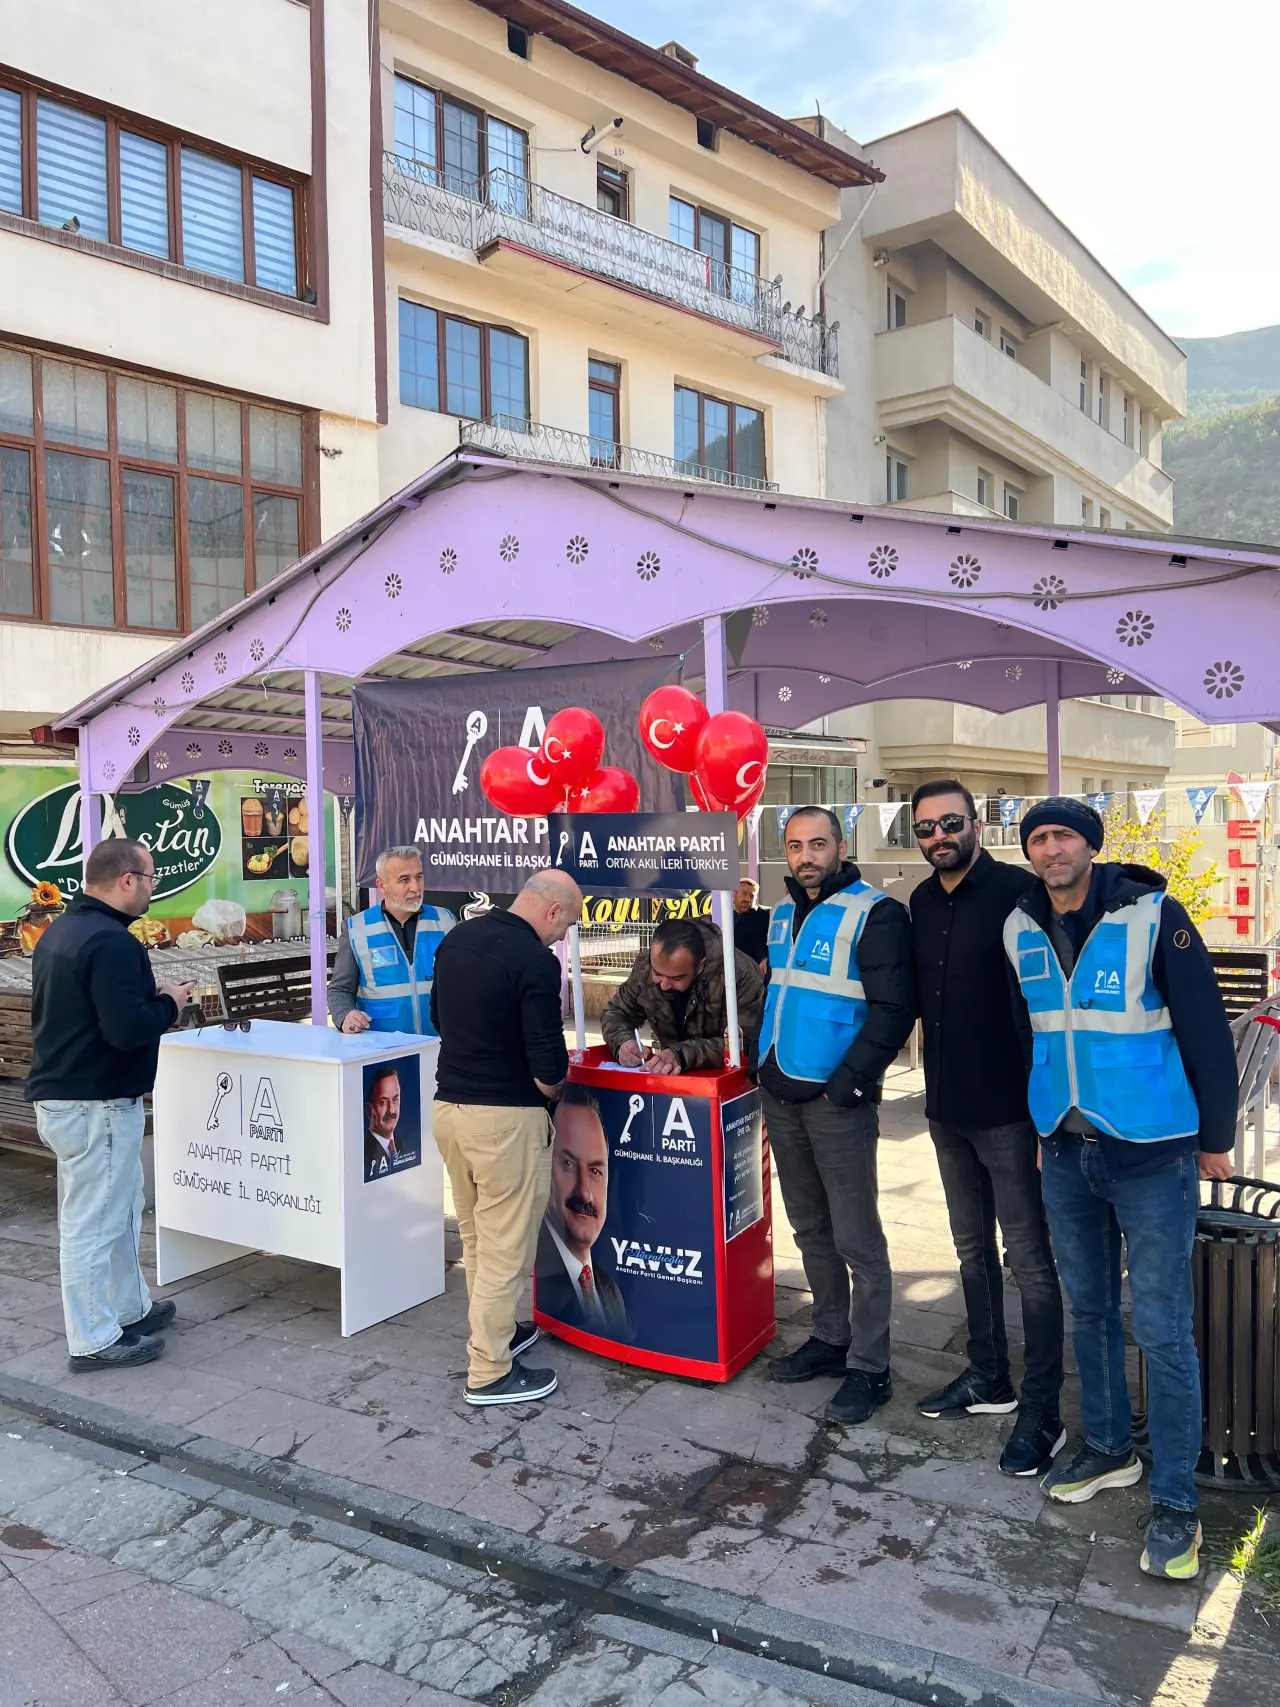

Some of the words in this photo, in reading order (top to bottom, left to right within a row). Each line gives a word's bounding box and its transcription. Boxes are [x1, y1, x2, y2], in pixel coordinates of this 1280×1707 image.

[414, 818, 529, 844] ANAHTAR
[607, 836, 676, 852] ANAHTAR
[680, 832, 725, 852] PARTİ
[579, 831, 598, 859] A
[430, 851, 502, 869] GÜMÜŞHANE
[503, 852, 514, 867] İL
[516, 855, 552, 870] BAŞKA
[606, 857, 636, 869] ORTAK
[638, 858, 659, 870] AKIL
[660, 855, 683, 870] İLERİ
[684, 856, 729, 871] TÜRKİYE
[1107, 971, 1120, 985] A
[250, 1077, 283, 1127] A
[662, 1097, 695, 1139] A
[187, 1142, 242, 1166] ANAHTAR
[251, 1152, 291, 1176] PARTİ
[614, 1149, 654, 1161] GÜMÜŞHANE
[663, 1156, 703, 1167] BAŞKANLIĞI
[173, 1169, 232, 1196] GÜMÜŞHANE
[238, 1181, 250, 1200] İL
[256, 1188, 321, 1214] BAŞKANLIĞI
[610, 1236, 703, 1278] YAVUZ
[616, 1265, 639, 1276] Anahtar
[656, 1273, 676, 1282] Genel
[676, 1276, 703, 1285] Başkanı
